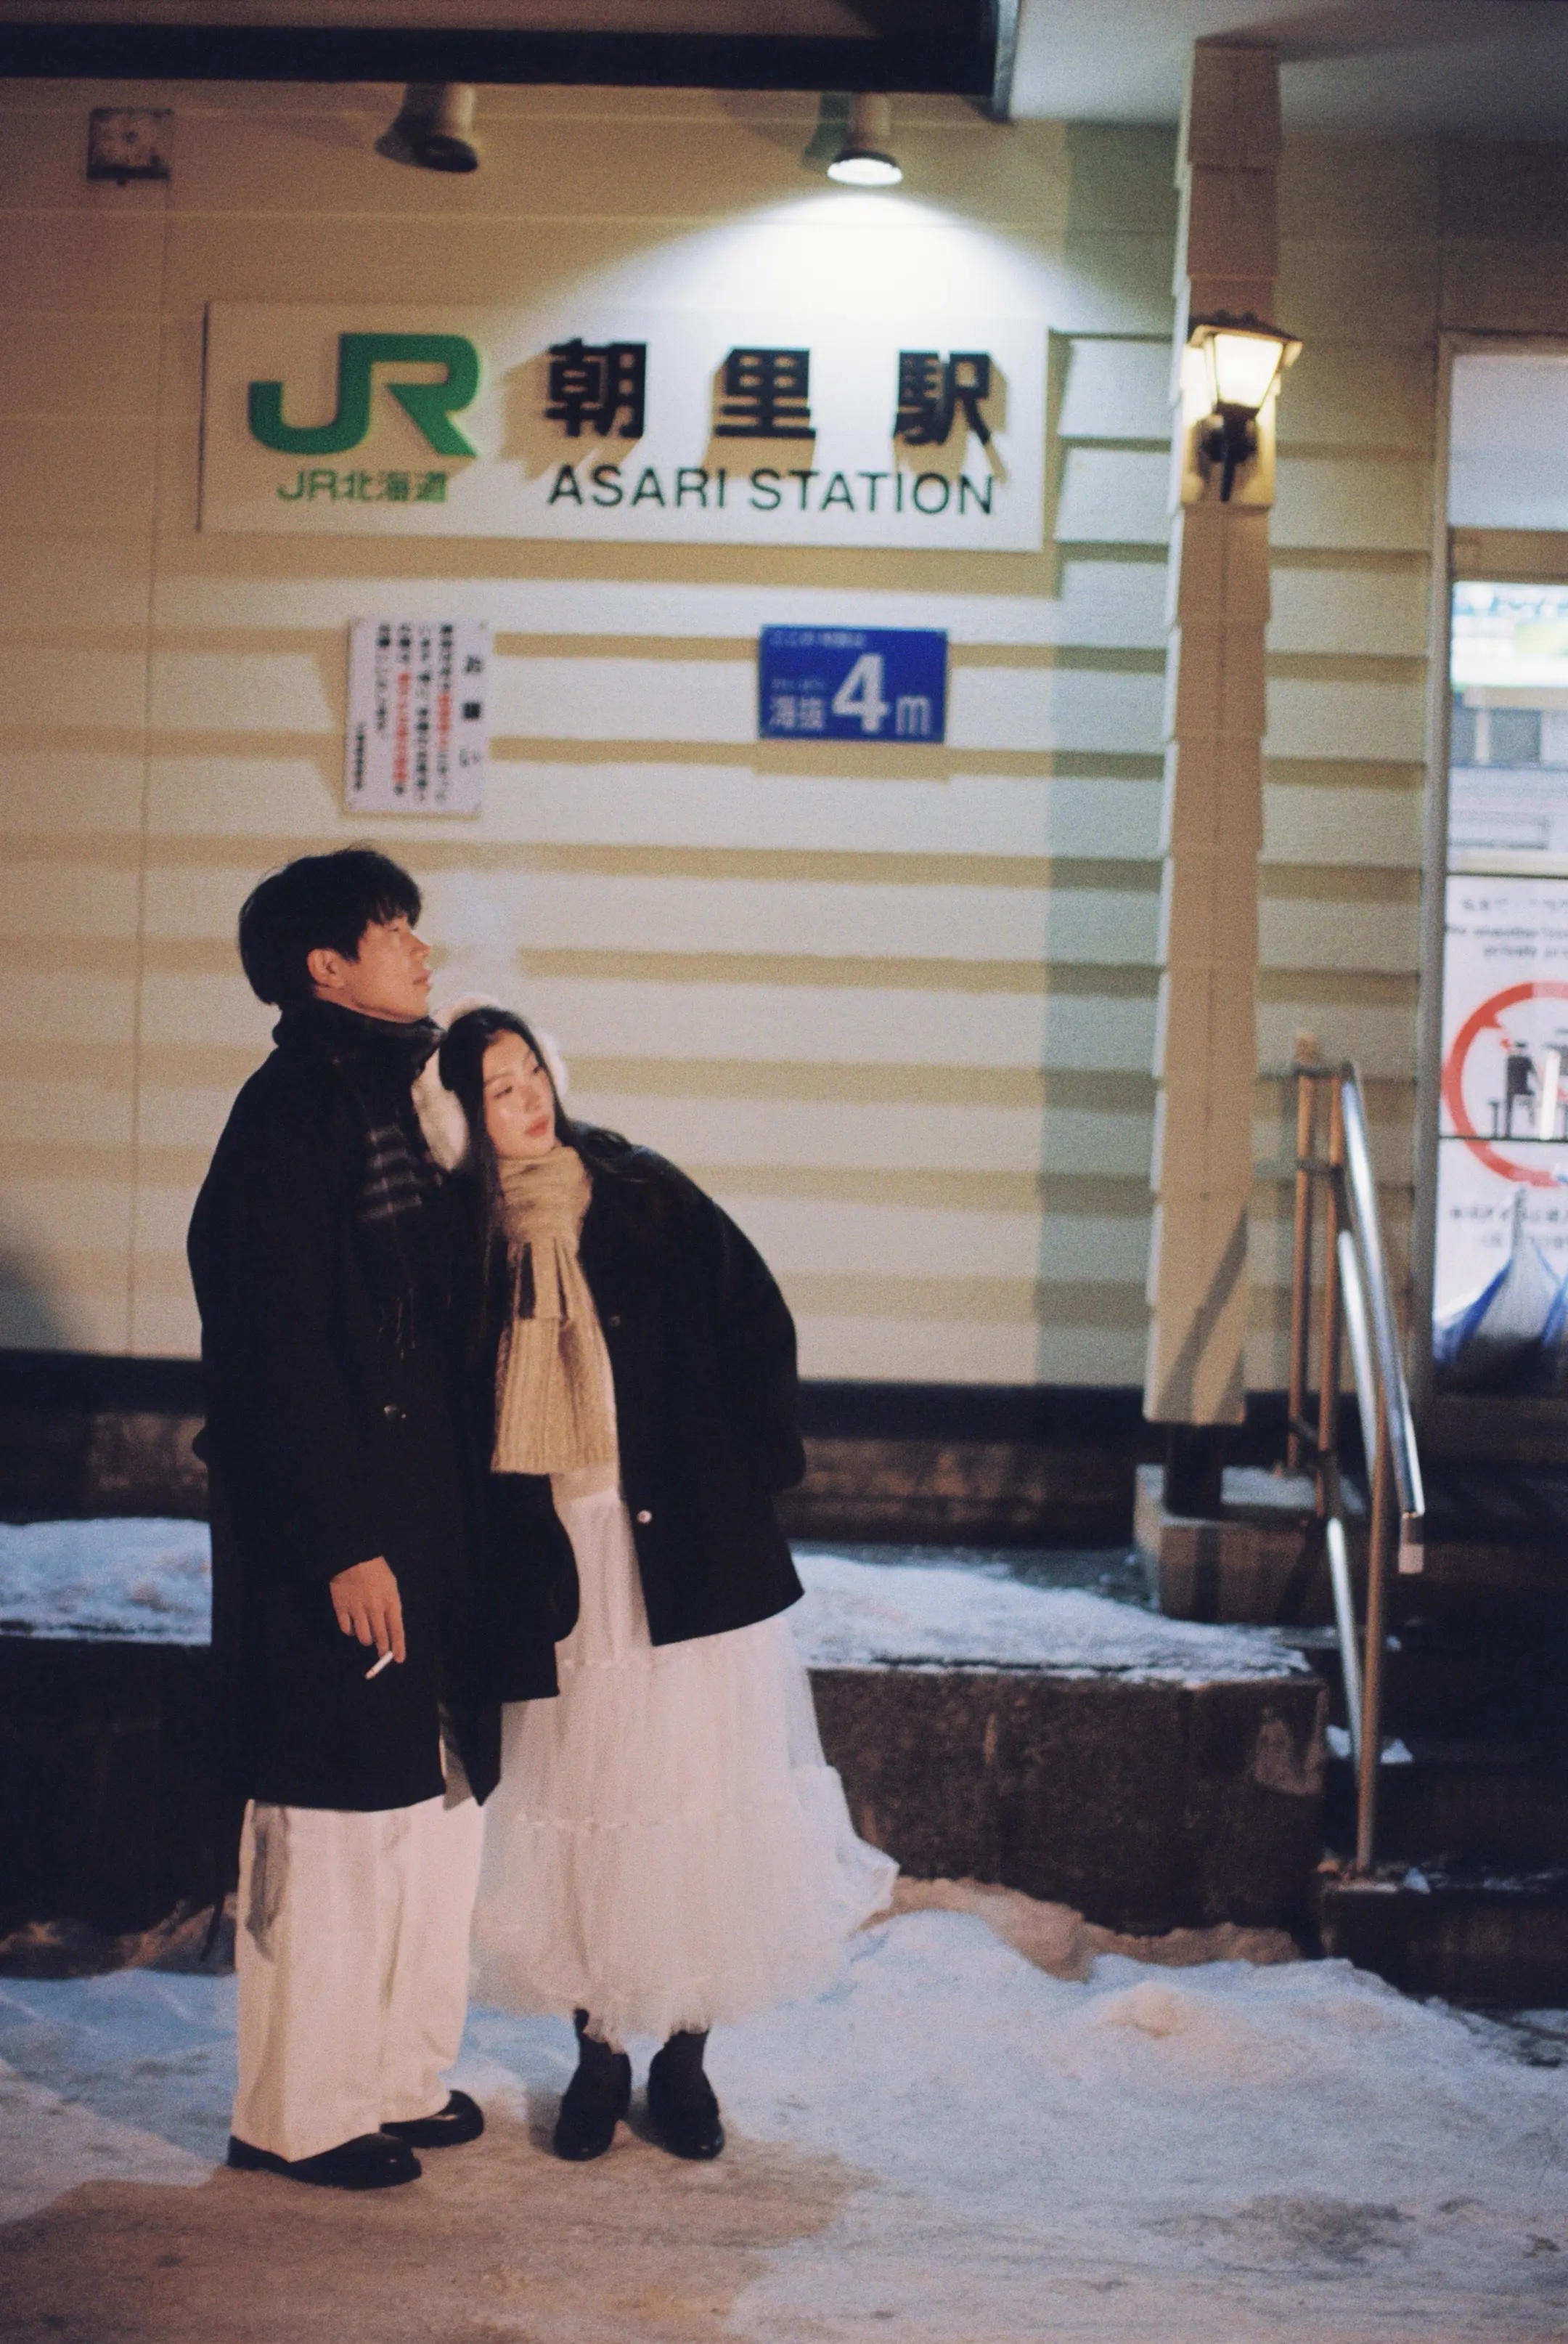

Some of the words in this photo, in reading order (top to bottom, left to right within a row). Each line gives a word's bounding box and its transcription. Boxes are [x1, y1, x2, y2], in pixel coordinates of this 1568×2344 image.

[248, 333, 479, 458] JR
[544, 338, 991, 446] 朝里駅
[276, 468, 448, 502] JR北海道
[547, 465, 727, 508] ASARI
[750, 468, 993, 515] STATION
